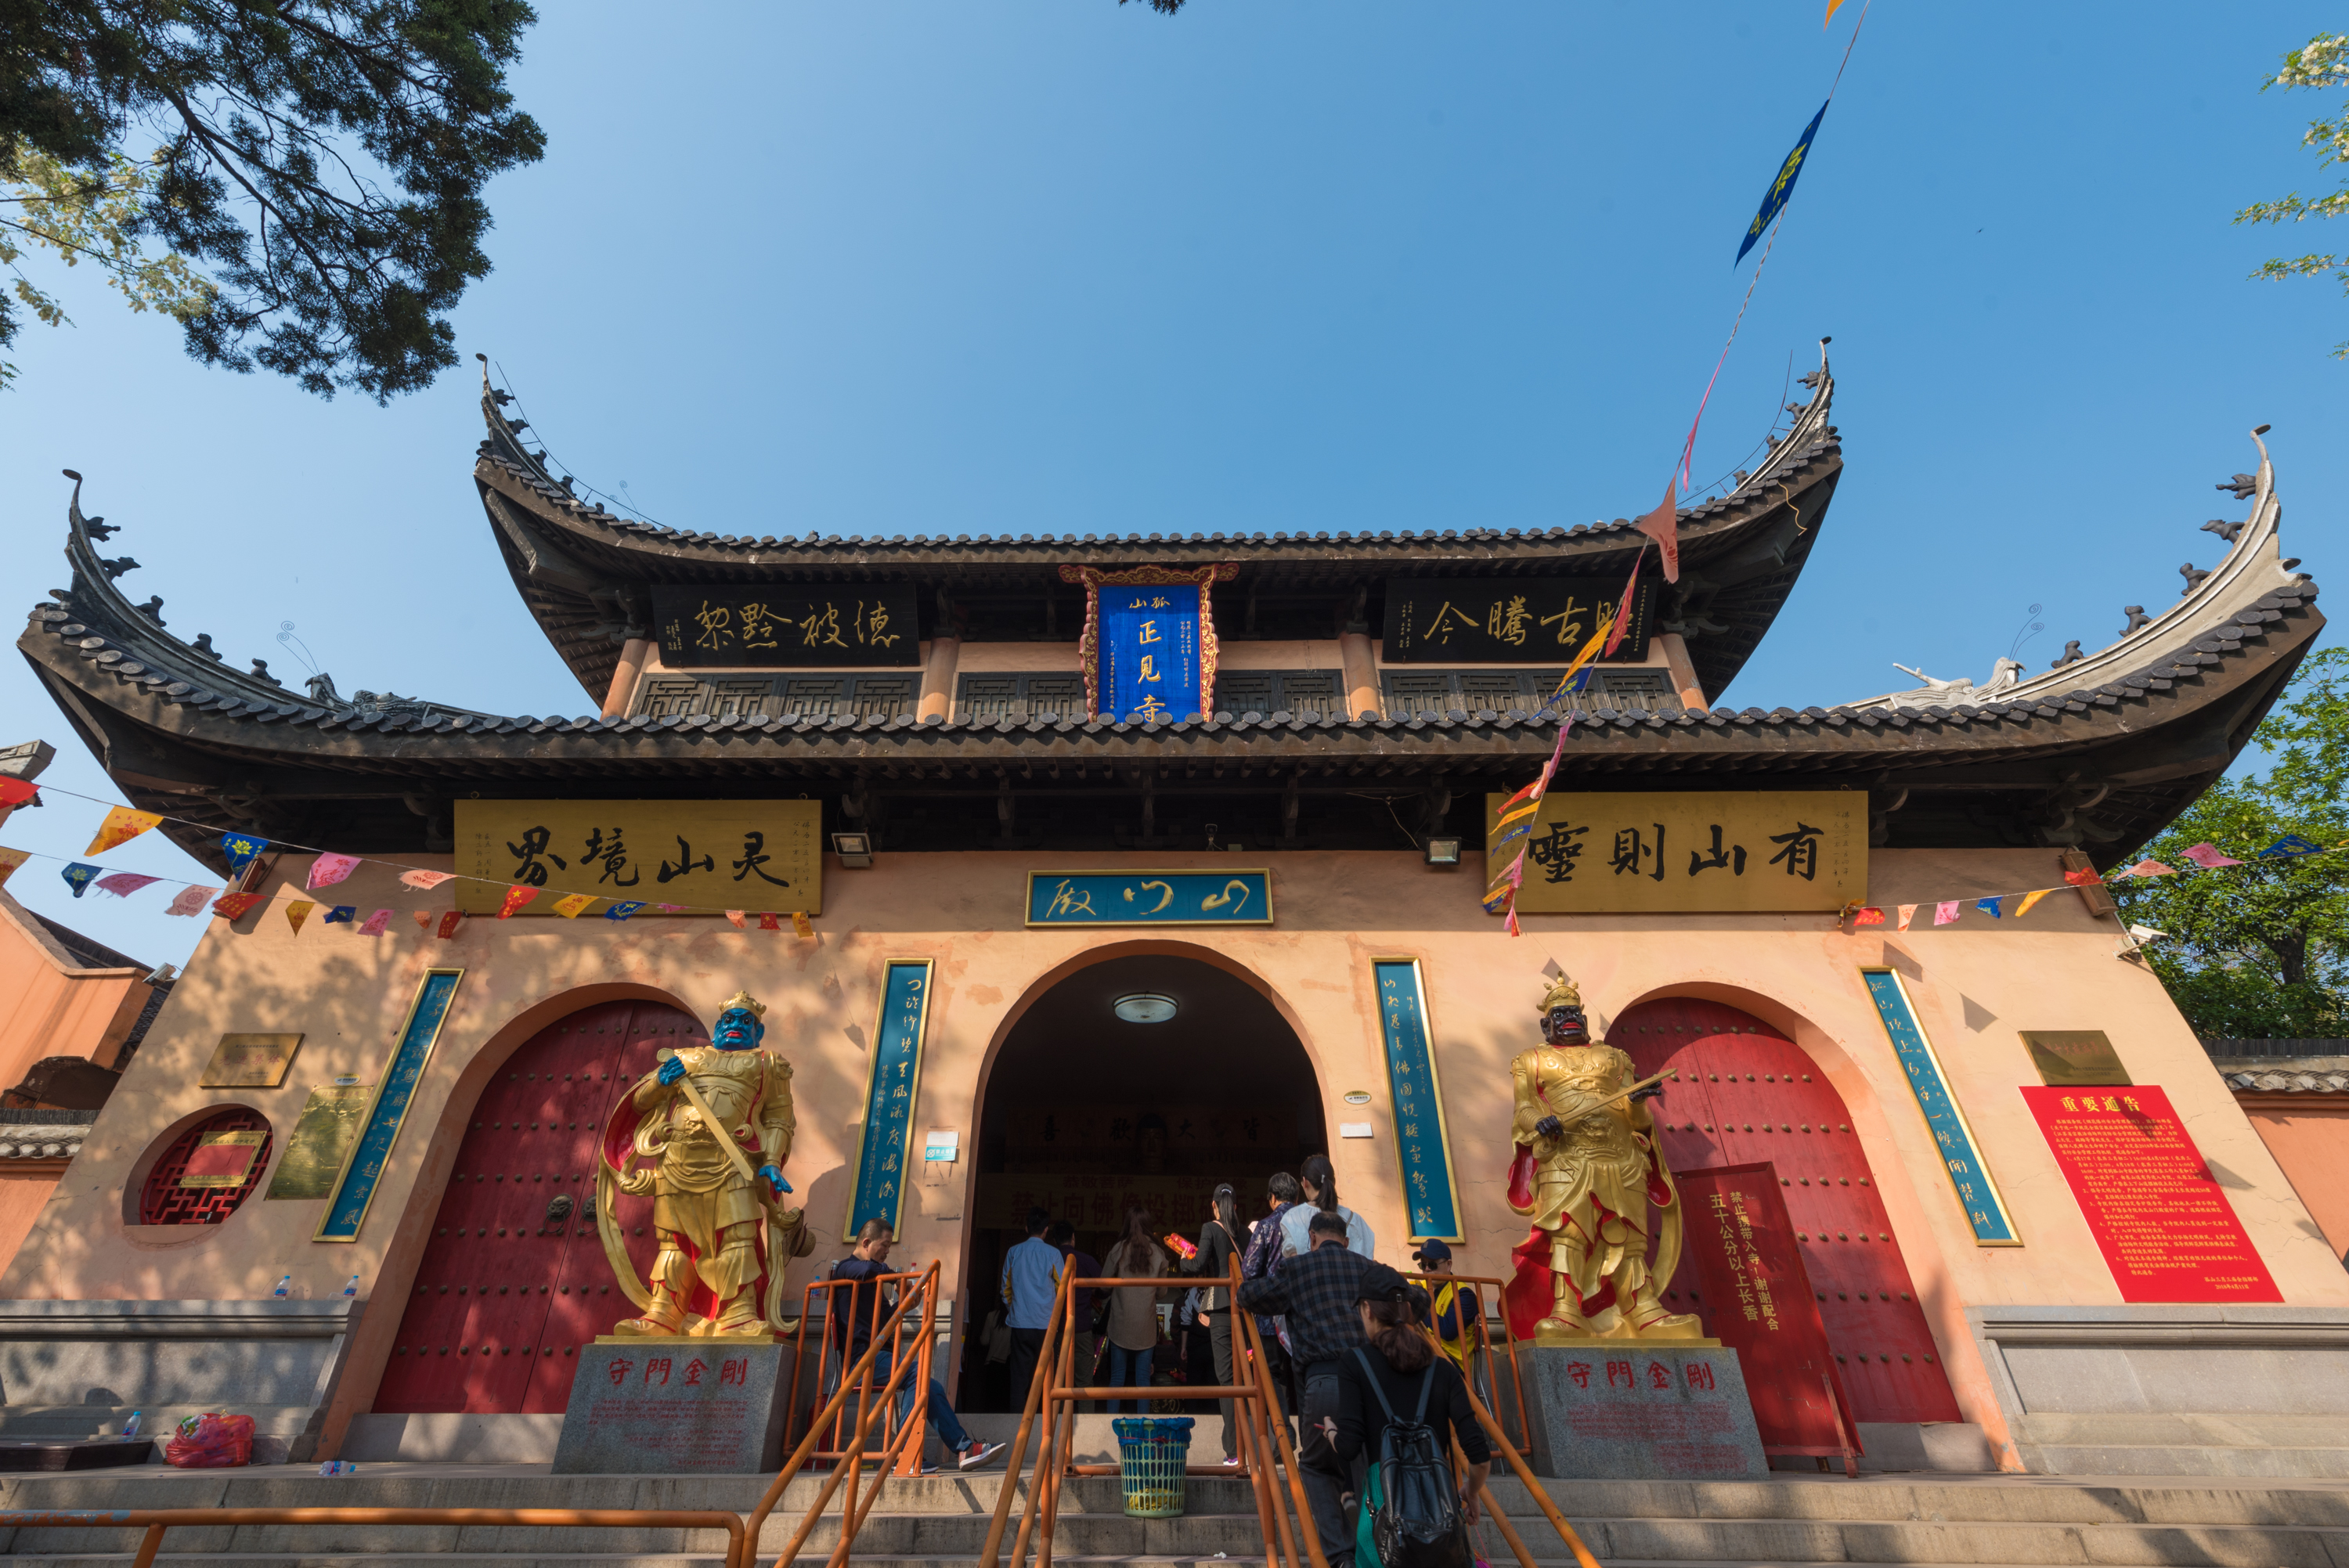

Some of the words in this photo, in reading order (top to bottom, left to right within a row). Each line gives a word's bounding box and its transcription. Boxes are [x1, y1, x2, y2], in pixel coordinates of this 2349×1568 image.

[1128, 597, 1170, 608] 孤山
[218, 1054, 281, 1067] 先进集体
[2060, 1096, 2139, 1112] 重要通告
[1063, 1175, 1134, 1188] 恭敬菩萨
[1709, 1194, 1759, 1321] 五十公分以上长香
[608, 1357, 748, 1386] 守門金剛
[1568, 1361, 1716, 1390] 守門金剛
